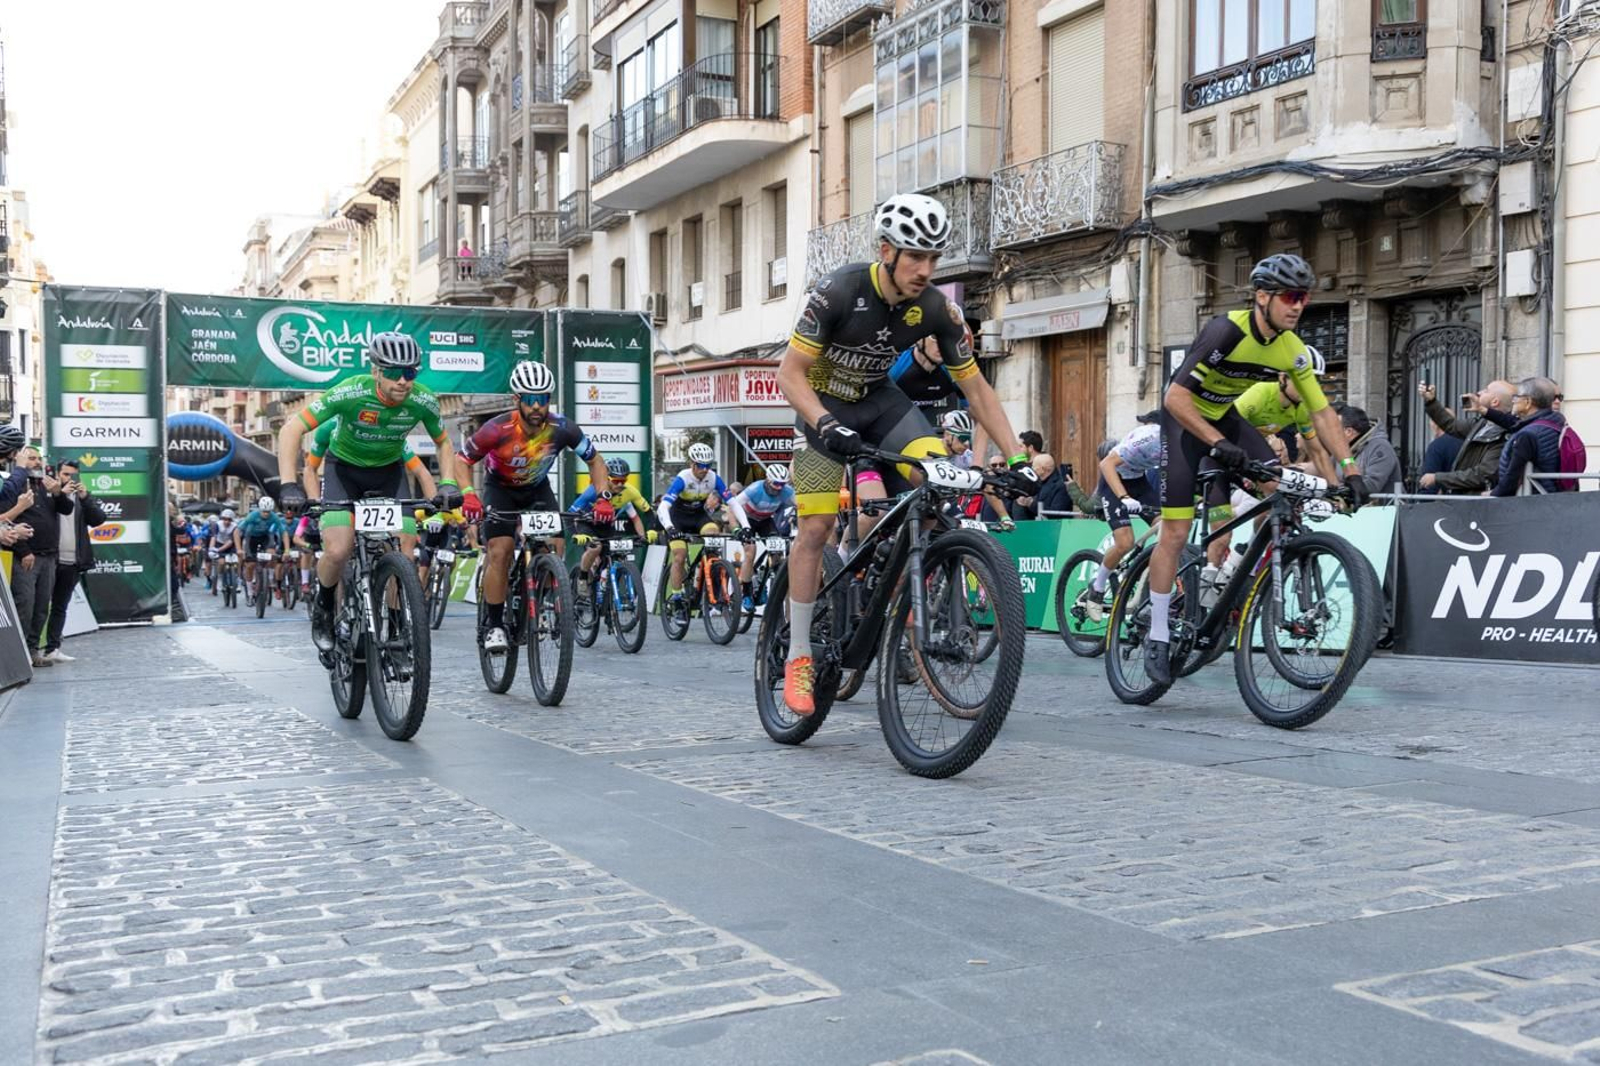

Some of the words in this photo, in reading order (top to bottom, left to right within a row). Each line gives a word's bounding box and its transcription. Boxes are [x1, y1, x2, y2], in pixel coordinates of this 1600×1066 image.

[191, 328, 238, 340] GRANADA
[191, 340, 217, 351] JAÉN
[191, 352, 237, 363] CÓRDOBA
[302, 346, 355, 368] BIKE
[435, 356, 479, 366] GARMIN
[712, 372, 740, 404] JAVIER
[745, 380, 780, 395] JAVI
[70, 427, 141, 438] GARMIN
[168, 439, 224, 451] ARMIN
[752, 438, 793, 450] JAVIER
[363, 507, 395, 527] 27-2
[529, 514, 555, 531] 45-2
[1431, 552, 1600, 620] NDL
[1480, 626, 1516, 642] PRO
[1528, 627, 1598, 644] HEALTH
